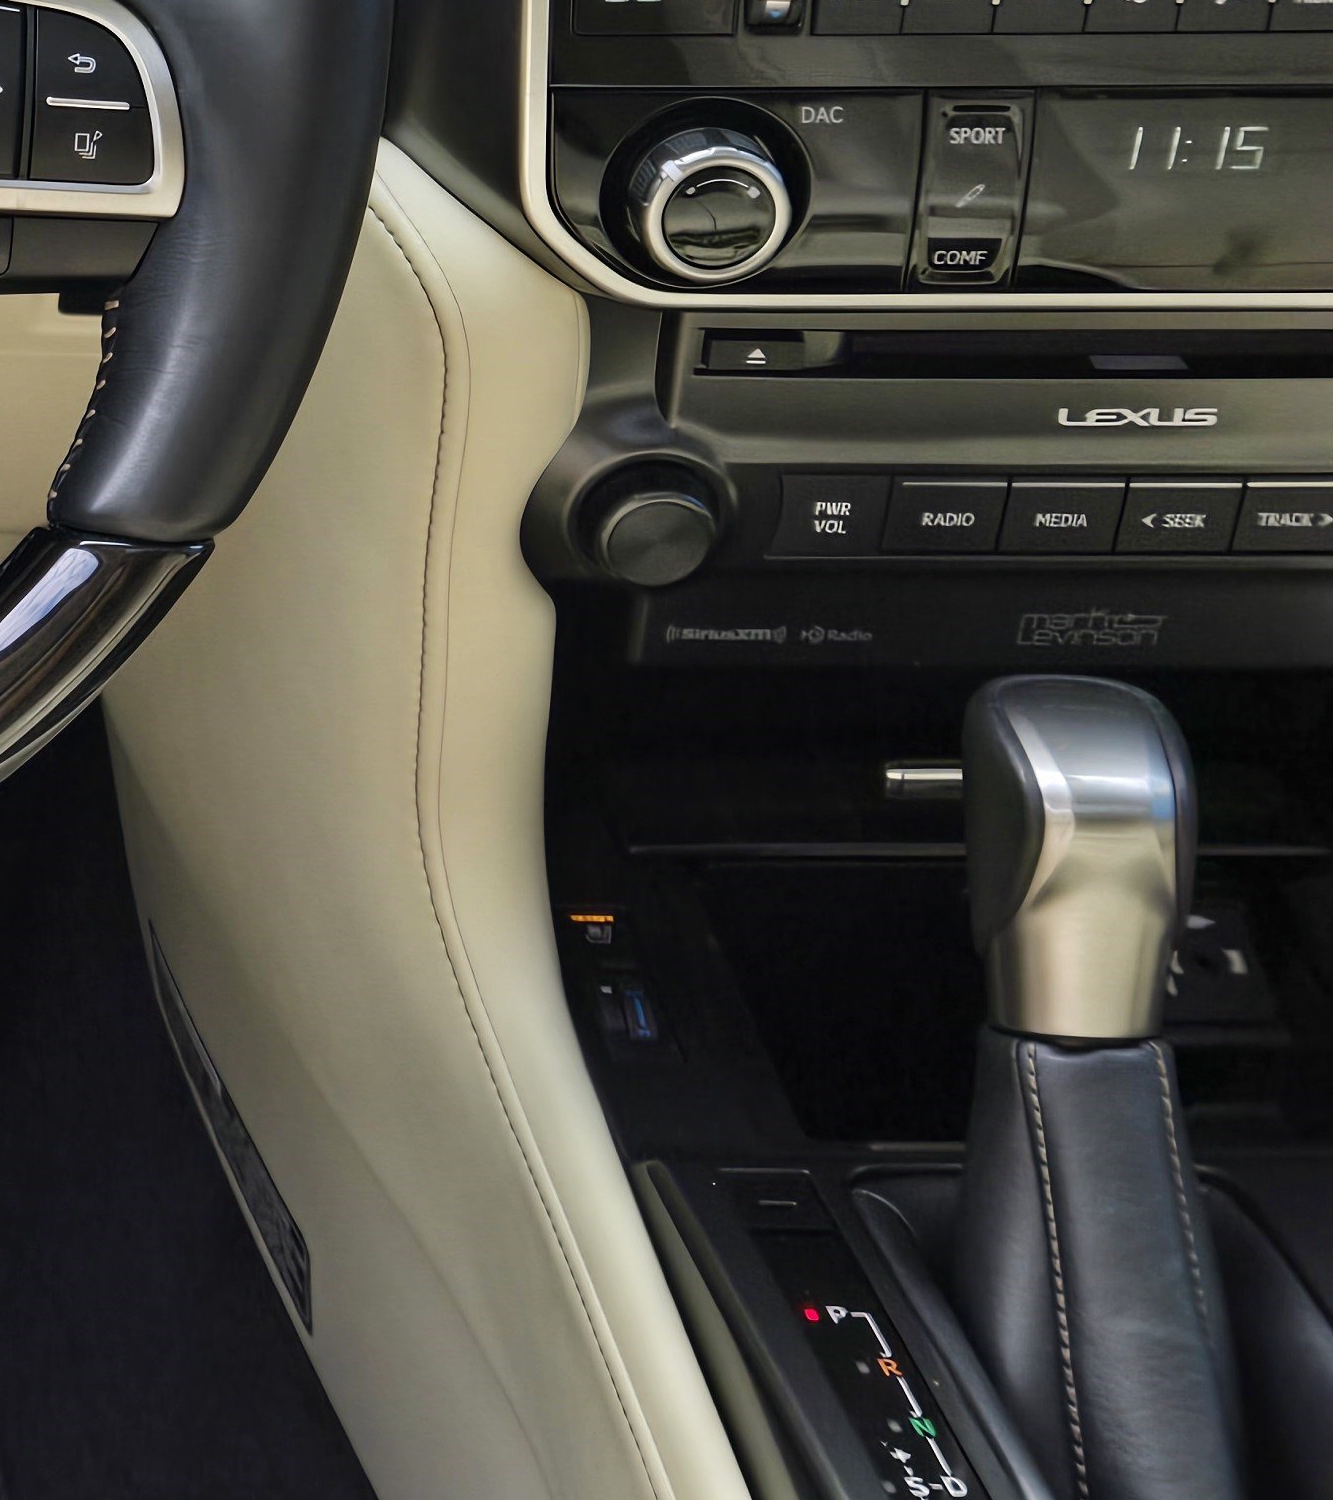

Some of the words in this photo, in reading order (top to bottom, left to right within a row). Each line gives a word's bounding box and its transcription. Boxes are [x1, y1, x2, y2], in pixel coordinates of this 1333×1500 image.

[801, 105, 844, 124] DAC
[949, 127, 1006, 145] SPORT
[1128, 125, 1269, 171] 11:15
[933, 250, 988, 265] COMF
[1057, 407, 1219, 427] LEXUS
[814, 501, 852, 516] PWR
[813, 519, 847, 535] VOL
[921, 512, 976, 527] RADIO
[1034, 512, 1088, 528] MEDIA
[1161, 513, 1207, 528] SEEK
[1258, 512, 1314, 527] TRACK
[825, 1305, 849, 1324] P
[877, 1358, 903, 1377] R
[909, 1417, 936, 1437] N
[940, 1475, 967, 1498] D
